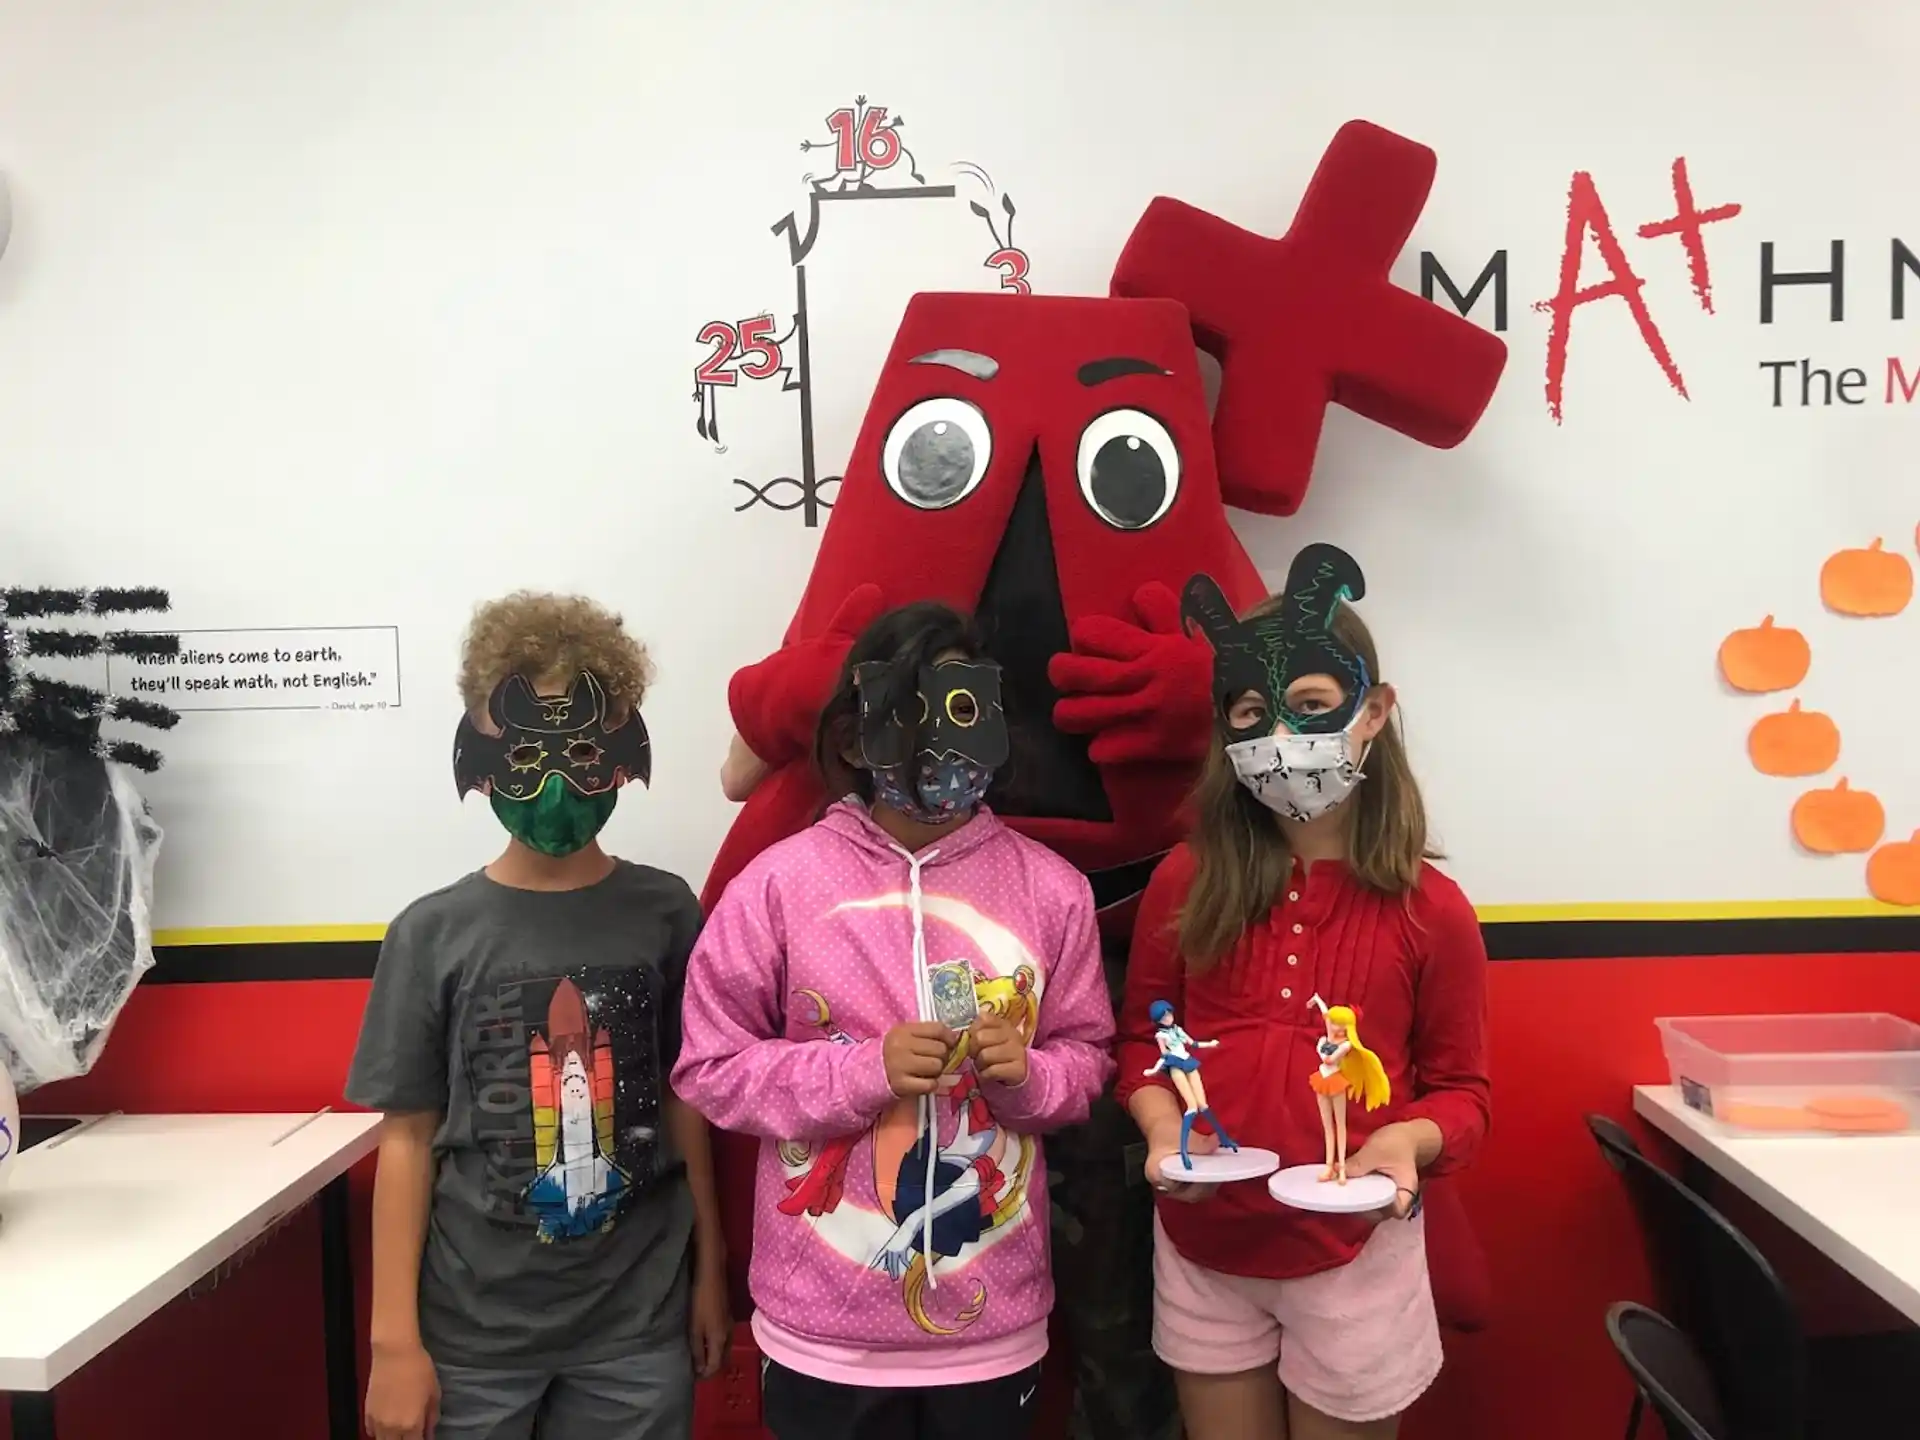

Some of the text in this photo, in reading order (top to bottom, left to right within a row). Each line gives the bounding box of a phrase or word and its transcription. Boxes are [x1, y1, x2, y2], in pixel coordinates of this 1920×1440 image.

[825, 106, 902, 172] 16
[695, 313, 784, 388] 25
[1758, 357, 1867, 407] The
[180, 649, 225, 665] aliens
[228, 651, 269, 664] come
[273, 648, 292, 662] to
[294, 646, 342, 663] earth,
[130, 676, 180, 693] they'll
[184, 675, 229, 692] speak
[233, 673, 278, 689] math,
[282, 673, 308, 688] not
[359, 703, 374, 712] age
